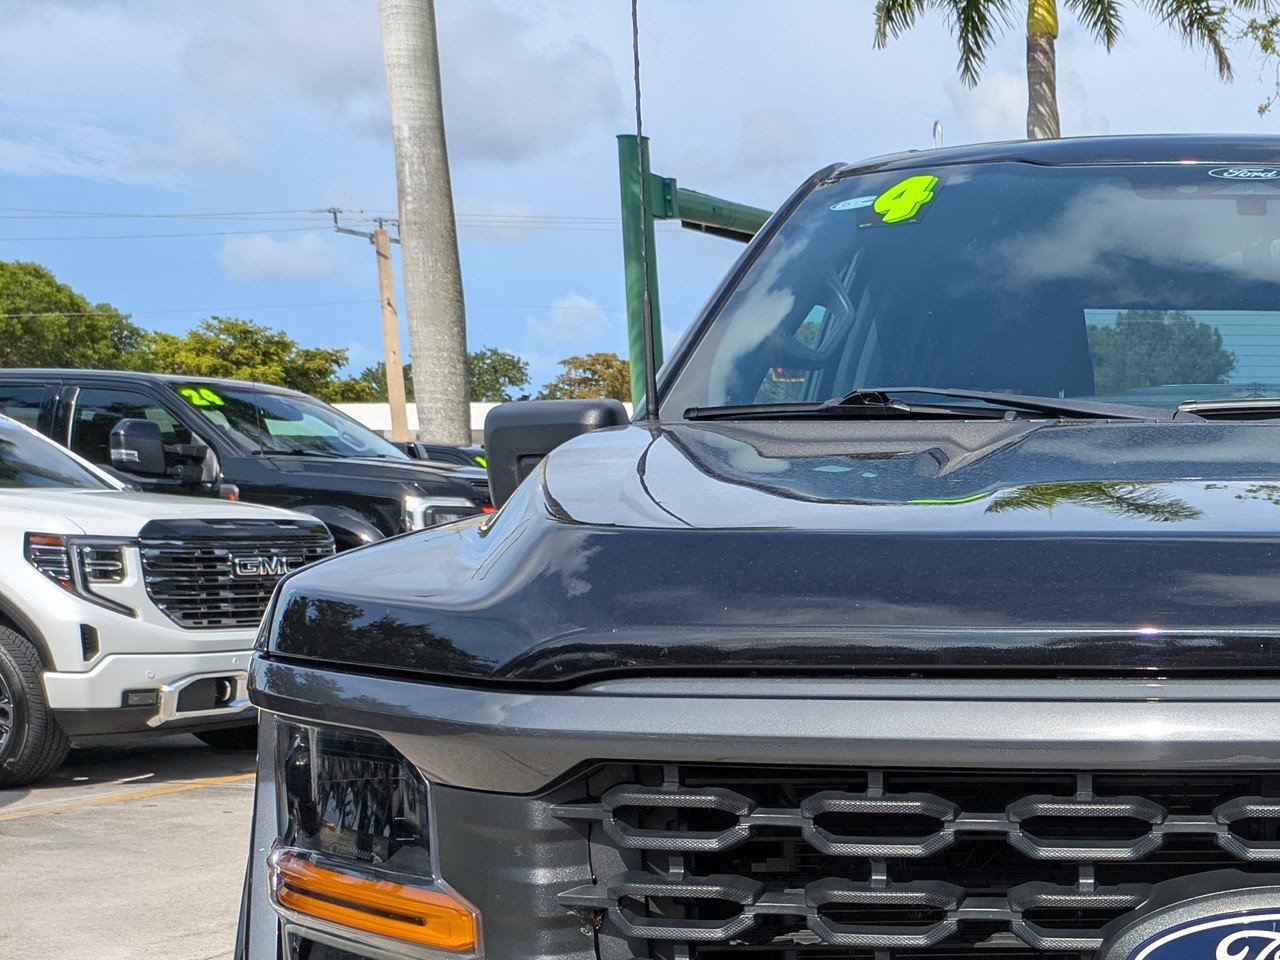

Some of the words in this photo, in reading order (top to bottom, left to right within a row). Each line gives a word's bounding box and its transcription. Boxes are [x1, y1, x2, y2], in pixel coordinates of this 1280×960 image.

[1222, 168, 1278, 178] Ford
[873, 174, 939, 223] 4
[180, 389, 226, 406] 24
[234, 556, 303, 576] GMC
